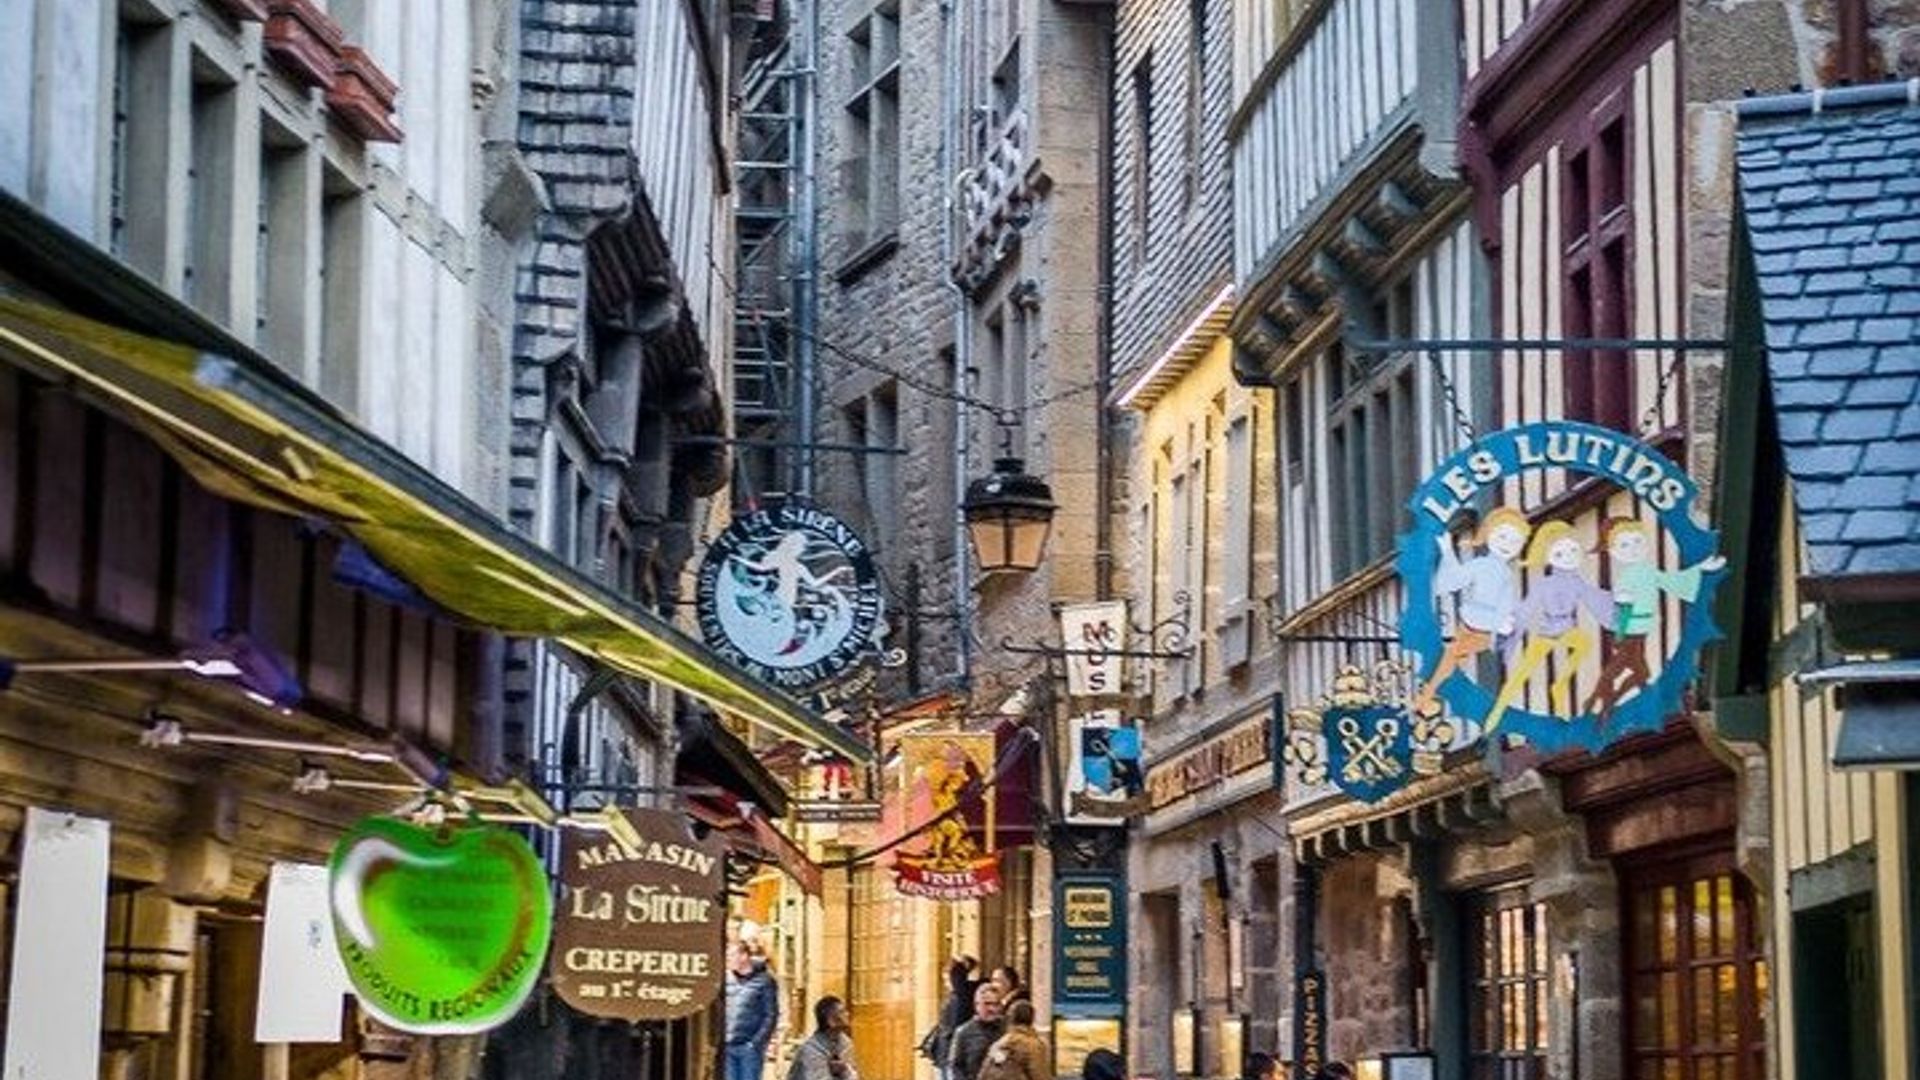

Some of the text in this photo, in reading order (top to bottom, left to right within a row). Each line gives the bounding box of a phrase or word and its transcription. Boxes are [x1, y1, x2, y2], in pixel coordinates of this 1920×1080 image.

[1424, 430, 1687, 523] LES LUTINS
[781, 506, 863, 557] SIRENE
[577, 841, 716, 876] MAASIN
[571, 883, 711, 924] La Sirène
[345, 941, 420, 1017] PRODUITS
[565, 947, 710, 977] CREPERIE
[579, 984, 607, 998] au
[638, 980, 694, 1006] étage
